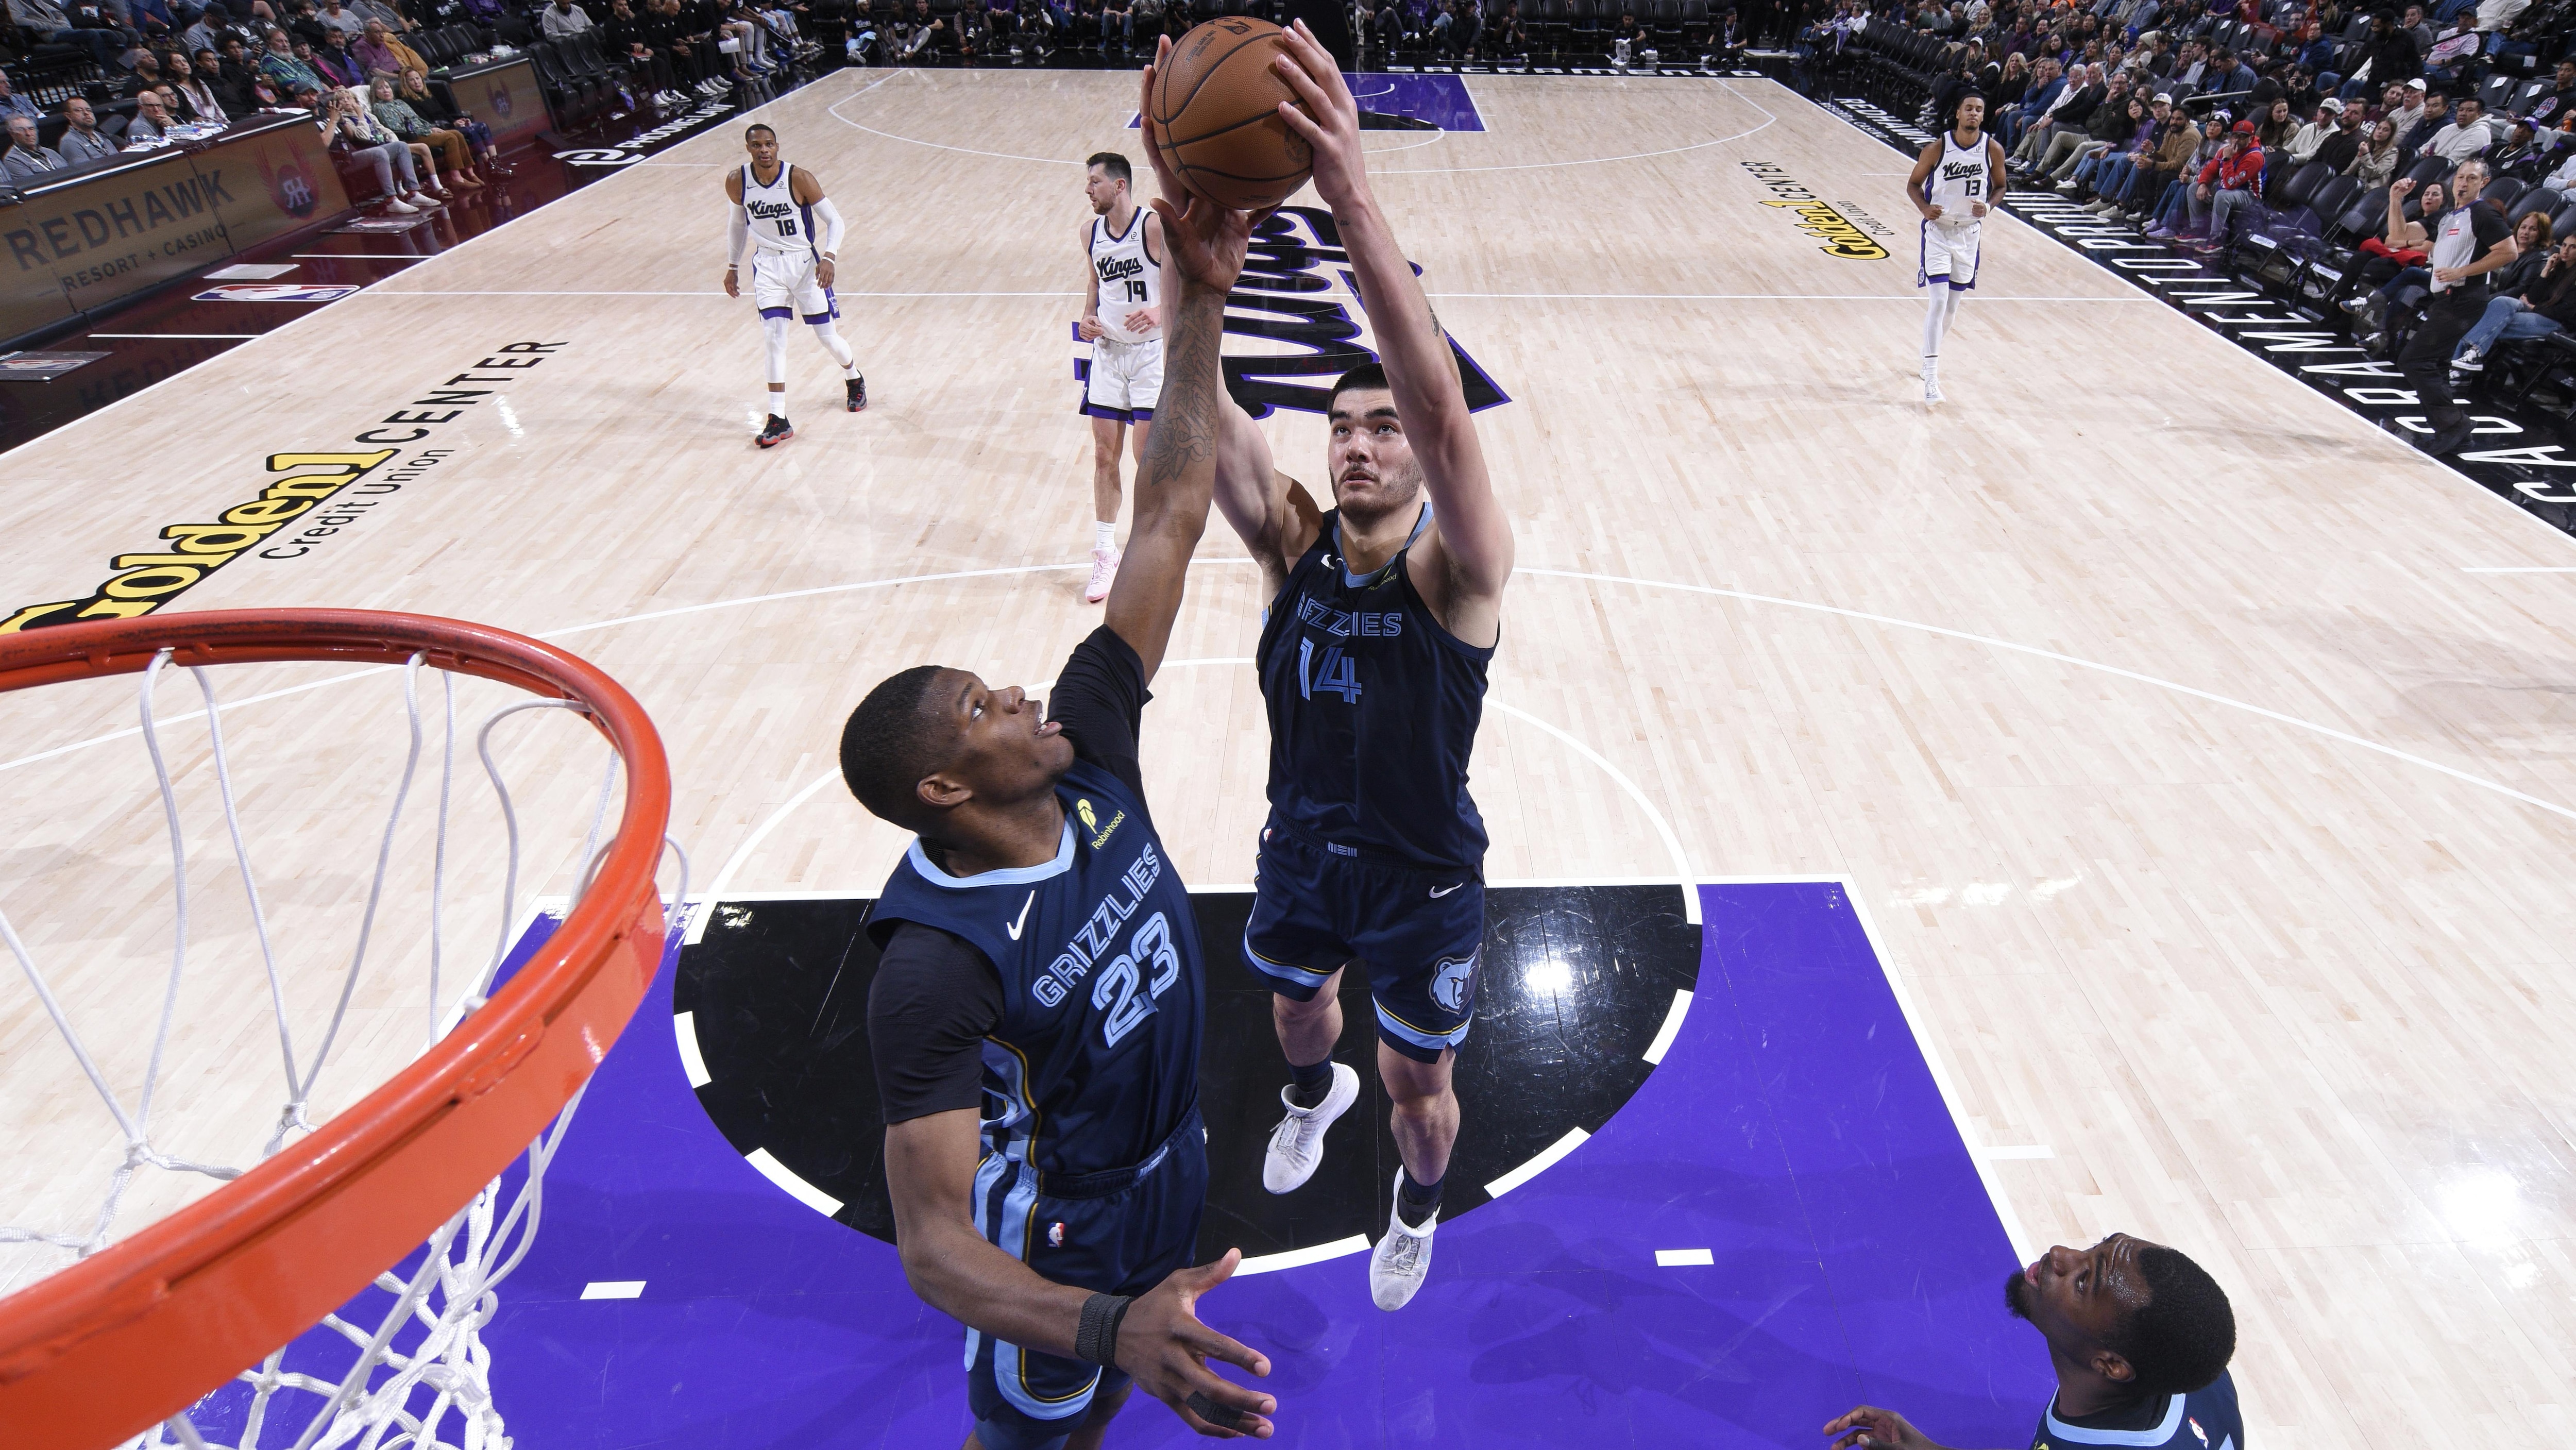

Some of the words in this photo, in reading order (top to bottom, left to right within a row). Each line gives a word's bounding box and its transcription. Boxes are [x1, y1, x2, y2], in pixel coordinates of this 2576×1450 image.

[1386, 65, 1762, 77] SACRAMENTO
[614, 117, 705, 148] PHOONG
[684, 104, 736, 118] LAW
[1834, 98, 1938, 144] REDHAWK
[1854, 122, 1889, 138] CASINO
[1740, 161, 1817, 199] CENTER
[1942, 161, 1983, 181] Kings
[1965, 179, 1981, 196] 13
[4, 169, 235, 272] REDHAWK
[747, 200, 792, 220] Kings
[775, 218, 798, 237] 18
[1836, 201, 1869, 216] Union
[1854, 217, 1895, 235] Credit
[2003, 192, 2167, 249] PROUD
[60, 253, 140, 292] RESORT
[163, 223, 228, 257] CASINO
[1096, 256, 1143, 283] Kings
[1124, 280, 1148, 303] 19
[354, 340, 570, 444] CENTER
[259, 501, 380, 559] Credit
[351, 449, 456, 495] Union
[1299, 636, 1362, 704] 14
[1091, 810, 1126, 850] Robinhood
[1032, 841, 1161, 1008] GRIZZLIES
[1091, 911, 1180, 1049] 23
